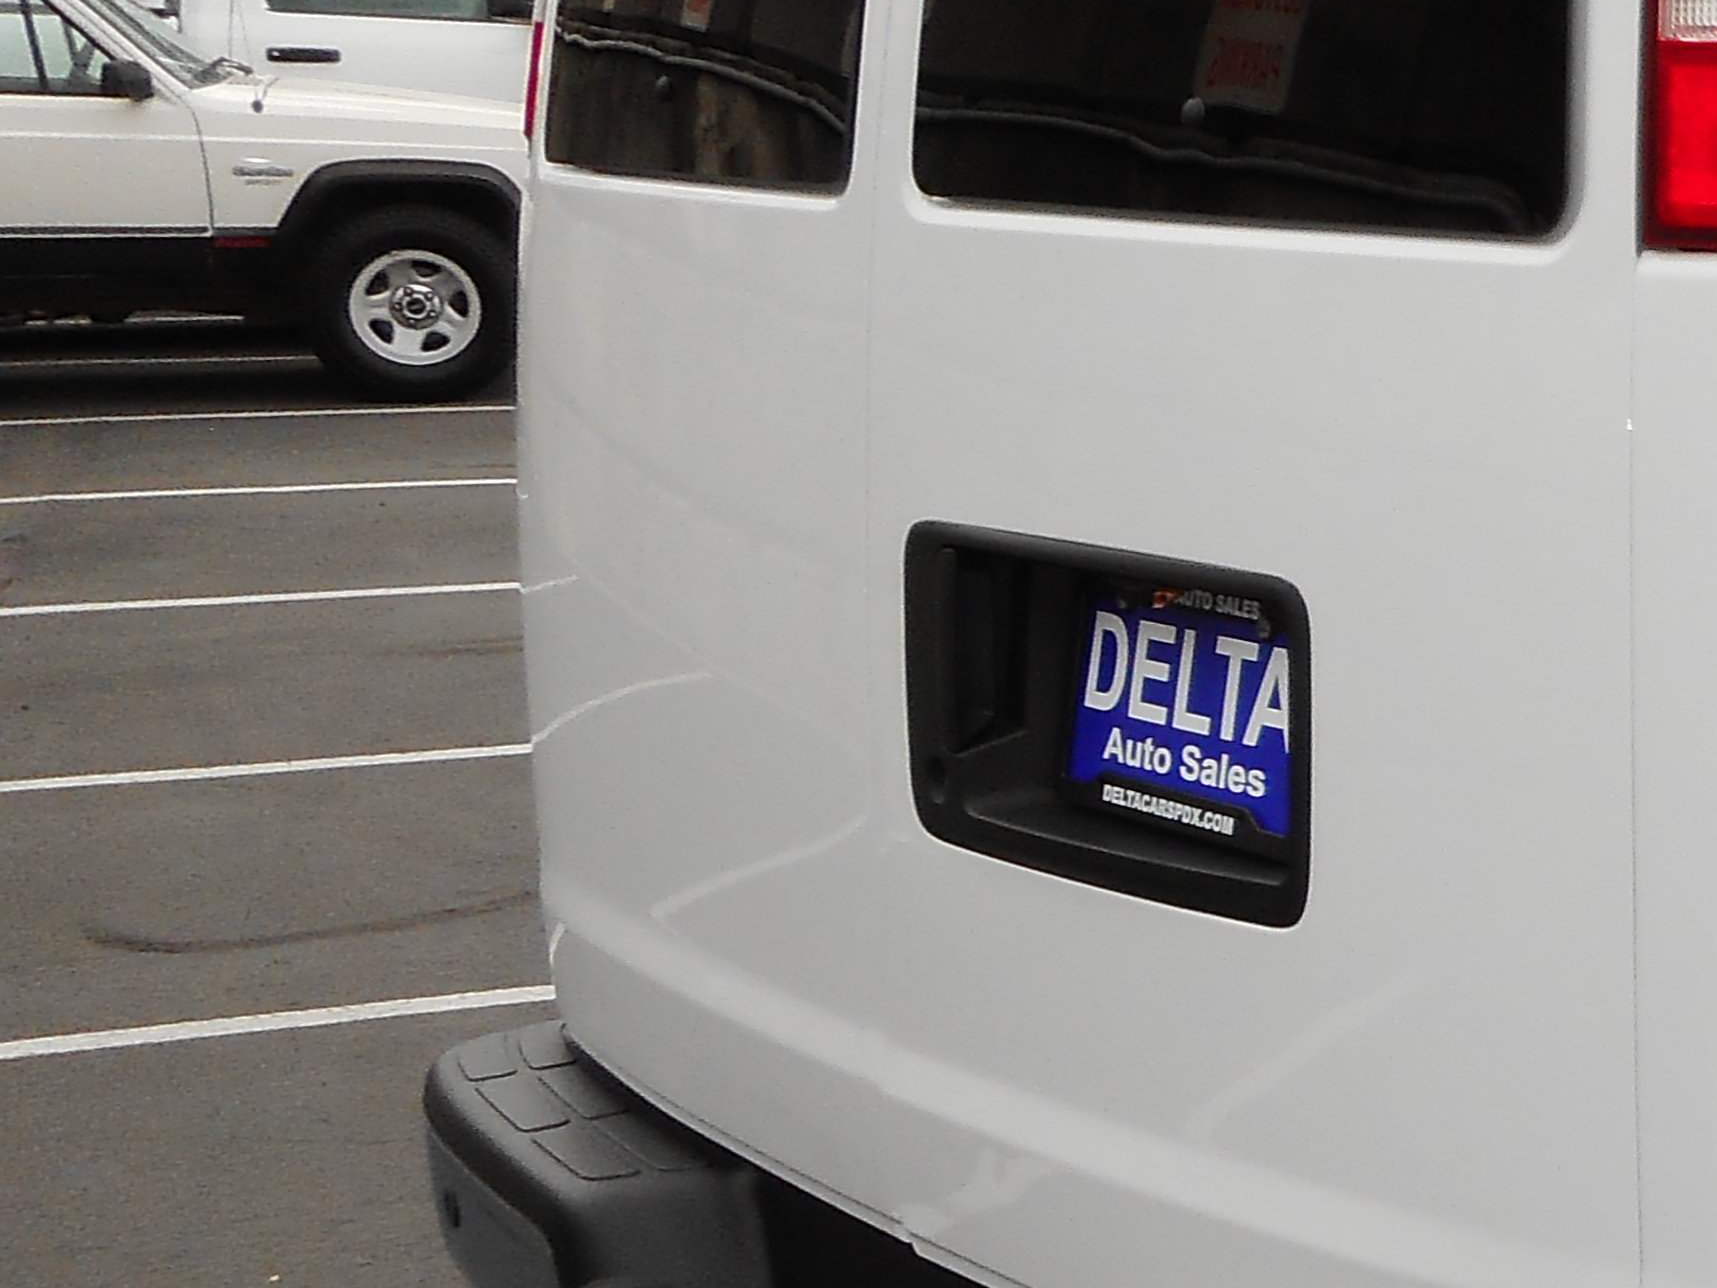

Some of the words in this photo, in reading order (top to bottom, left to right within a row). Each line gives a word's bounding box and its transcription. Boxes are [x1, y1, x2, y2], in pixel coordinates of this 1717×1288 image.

[1215, 595, 1261, 621] SALES
[1083, 610, 1290, 754] DELTA
[1102, 727, 1173, 776] Auto
[1179, 744, 1267, 798] Sales
[1102, 783, 1235, 836] DELTACARSPDX.COM
